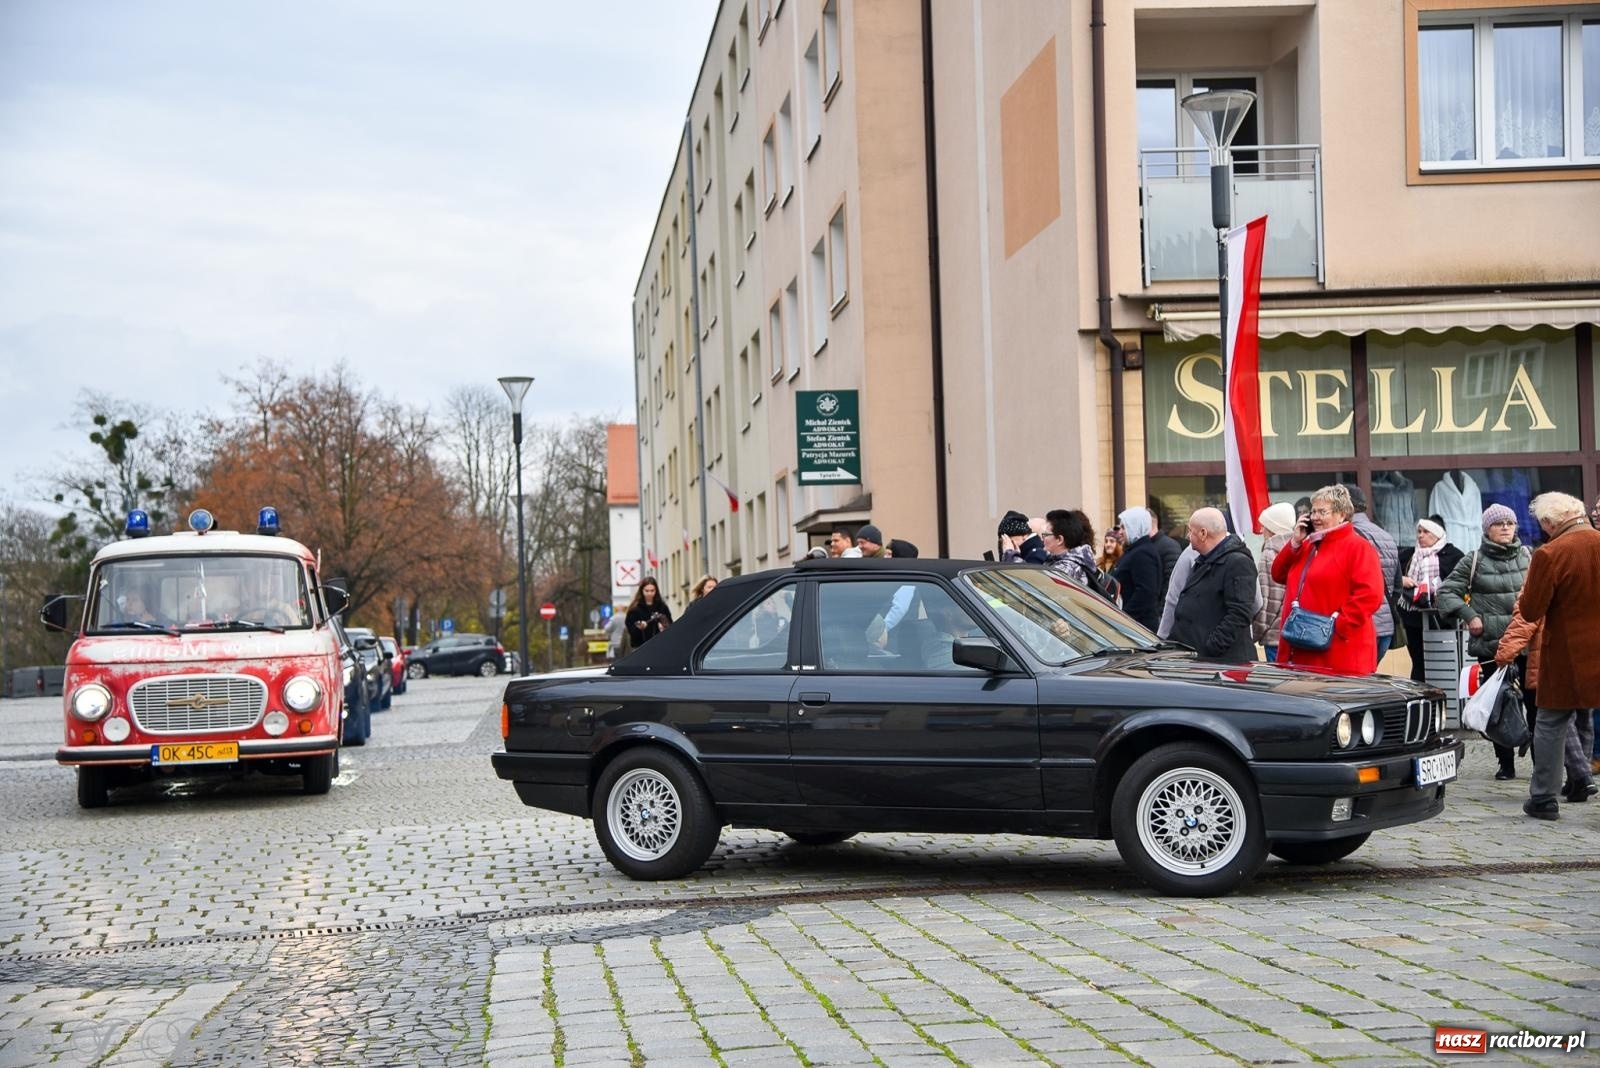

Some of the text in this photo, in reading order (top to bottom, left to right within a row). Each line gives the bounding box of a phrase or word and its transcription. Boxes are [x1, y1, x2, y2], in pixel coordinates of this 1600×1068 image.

[1167, 352, 1557, 440] STELLA
[801, 452, 828, 460] Patrycja
[162, 747, 181, 761] OK
[187, 745, 214, 760] 45C
[1422, 759, 1436, 782] SRC
